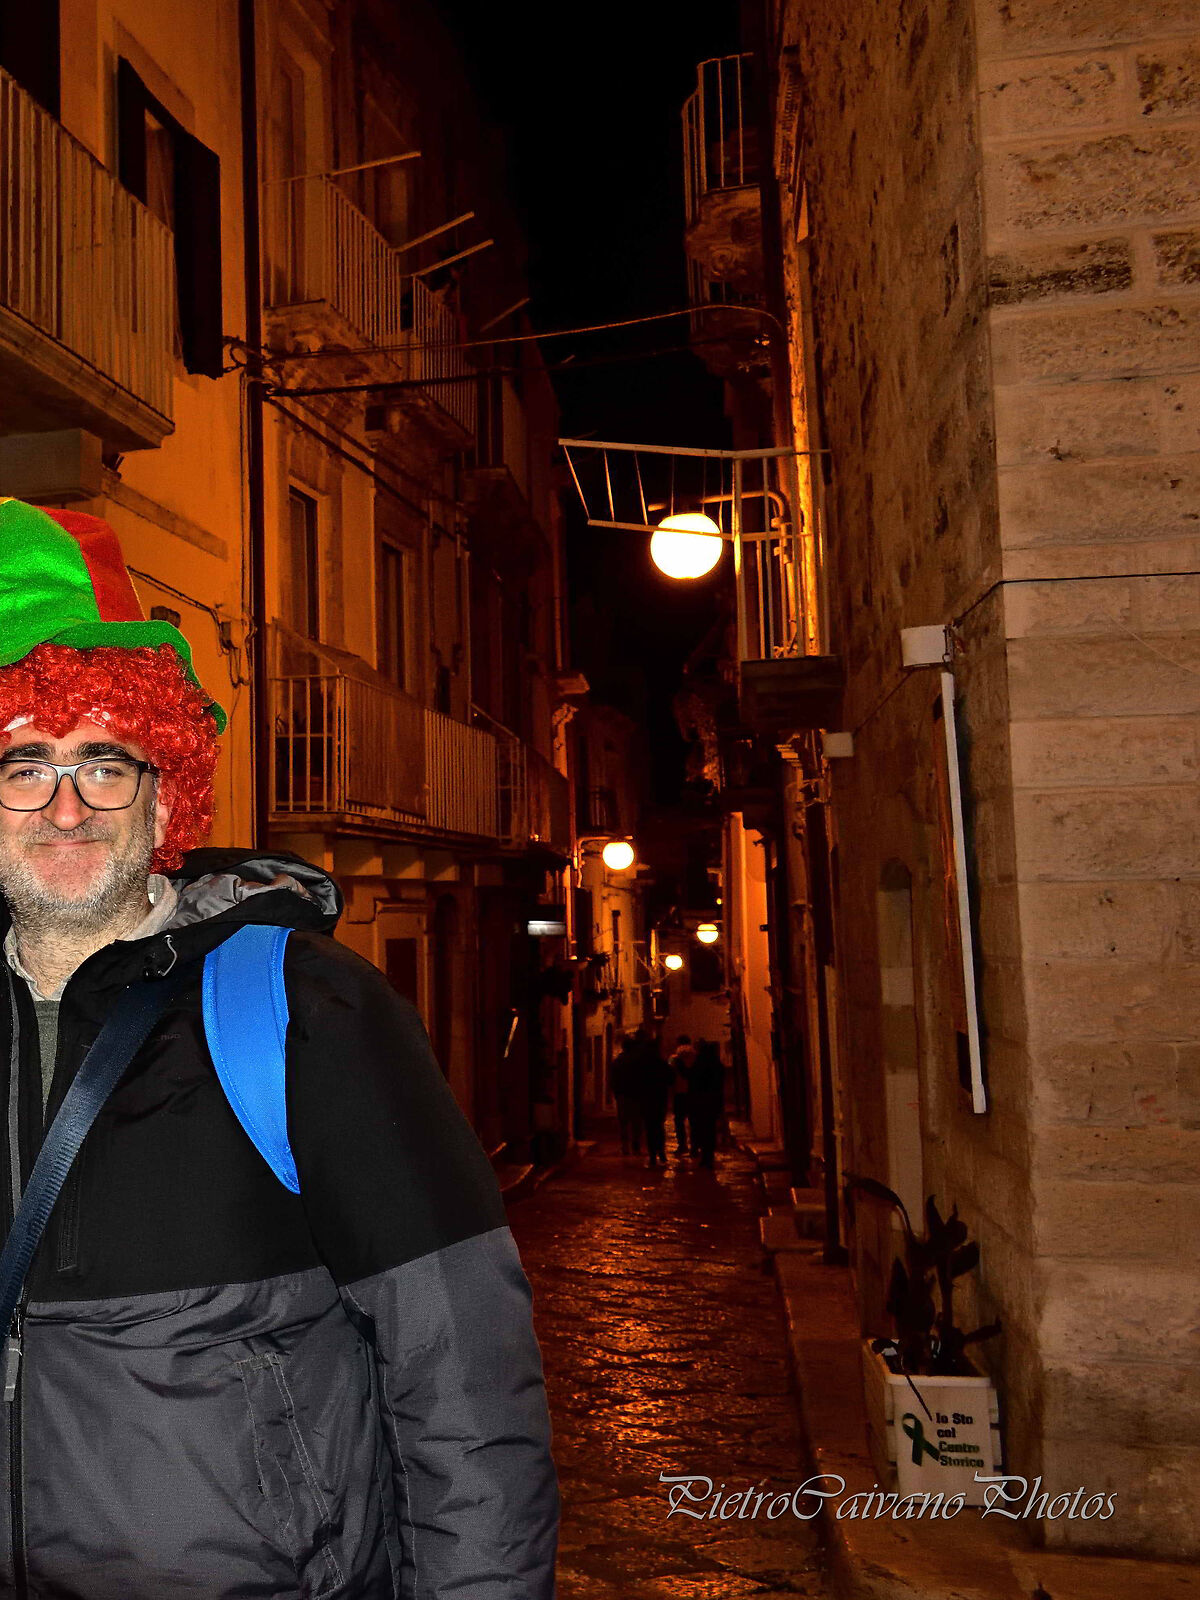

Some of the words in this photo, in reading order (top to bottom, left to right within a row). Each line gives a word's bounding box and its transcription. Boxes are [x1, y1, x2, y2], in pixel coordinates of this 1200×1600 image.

[952, 1412, 973, 1424] Sto
[939, 1441, 980, 1453] Centro
[940, 1455, 984, 1468] Storico
